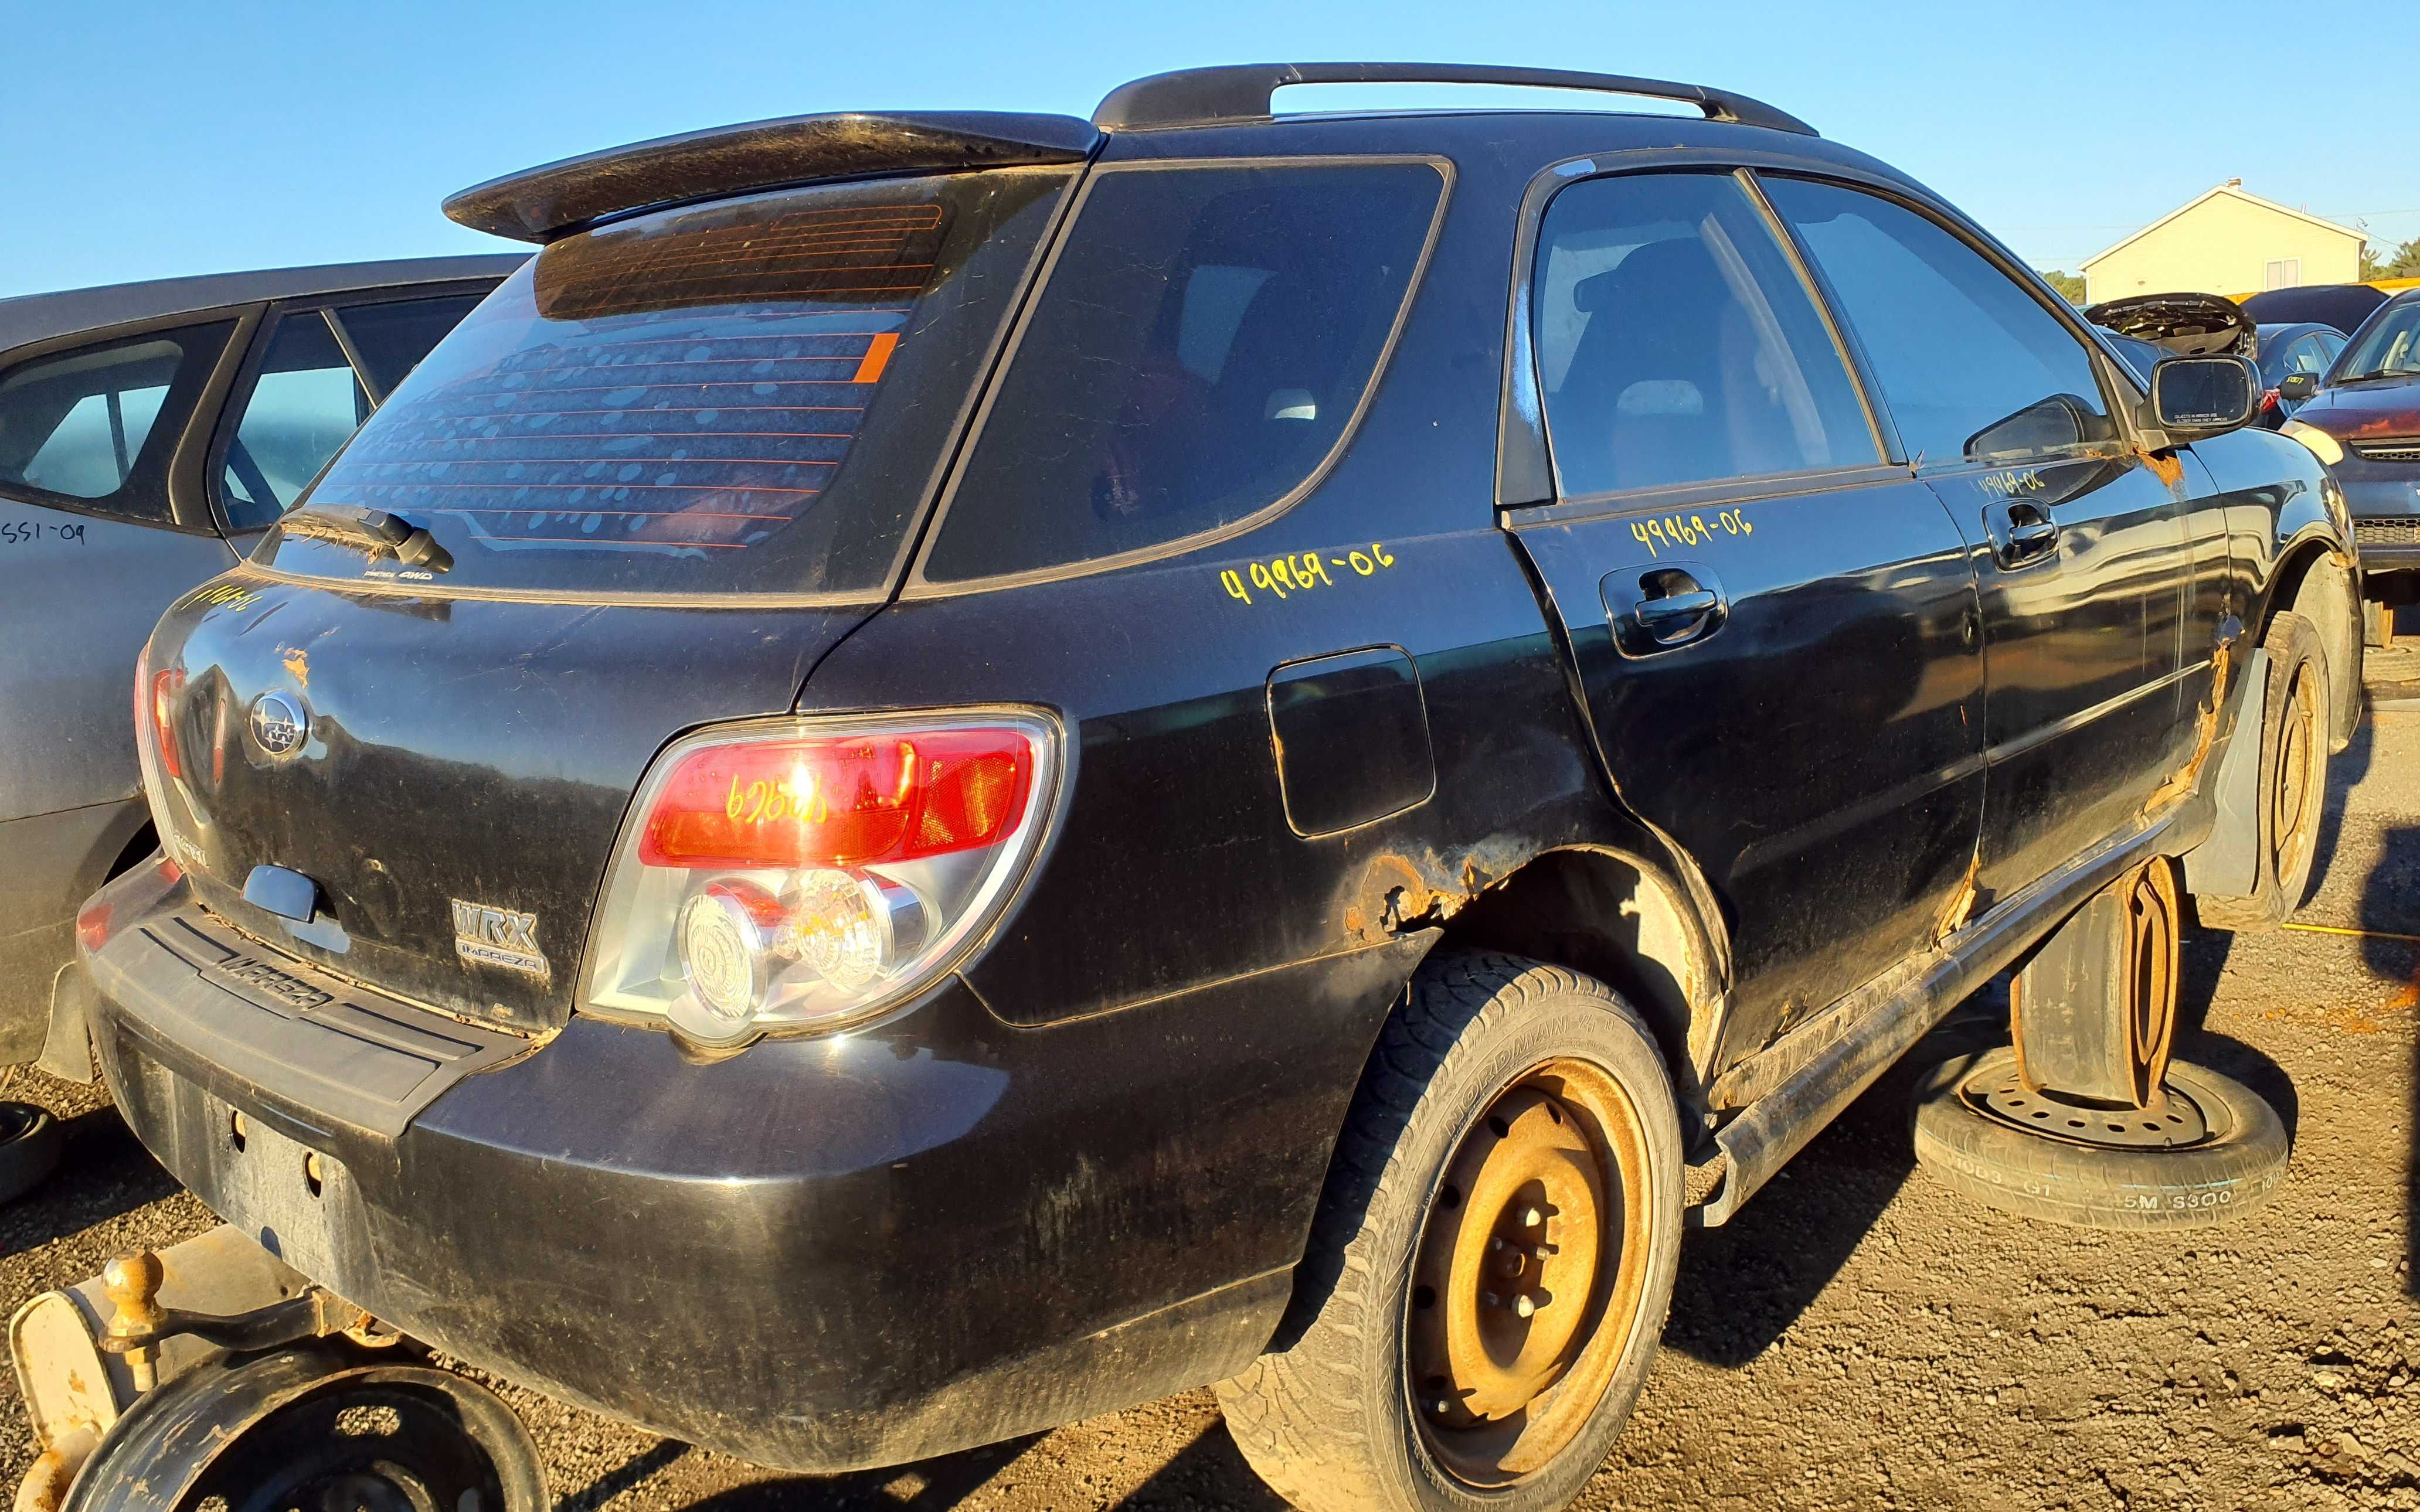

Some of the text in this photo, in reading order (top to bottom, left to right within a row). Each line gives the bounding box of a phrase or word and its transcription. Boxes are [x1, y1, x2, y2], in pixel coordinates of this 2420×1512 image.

[1630, 508, 1752, 558] 49969-06
[398, 571, 433, 580] AWD
[1221, 544, 1394, 605] 49969-06
[451, 901, 536, 950] WRX
[462, 945, 538, 969] IMPREZA
